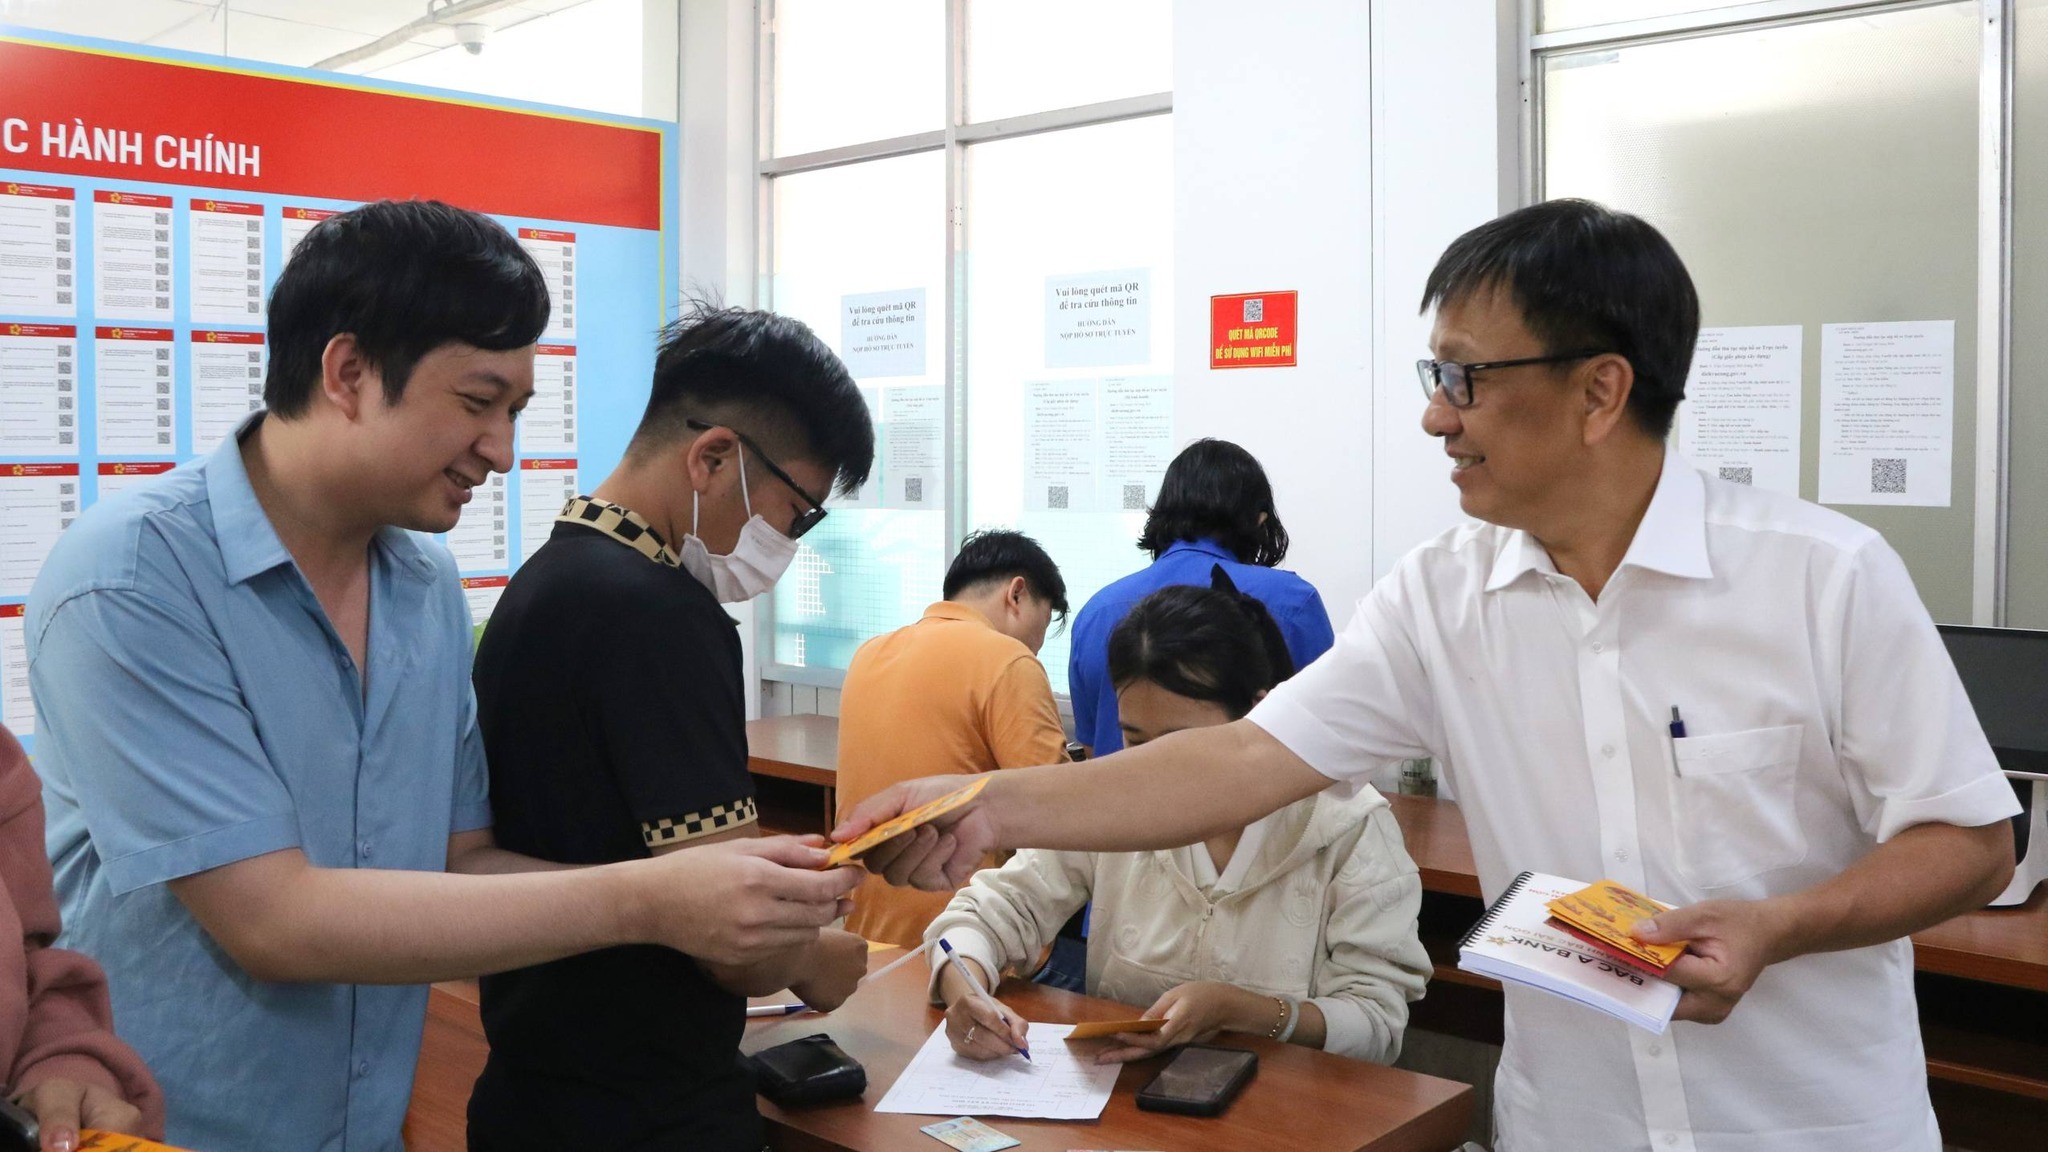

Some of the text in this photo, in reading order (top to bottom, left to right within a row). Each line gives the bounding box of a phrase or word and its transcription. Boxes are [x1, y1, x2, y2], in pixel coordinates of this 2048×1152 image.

[3, 118, 260, 177] C HÀNH CHÍNH
[1056, 282, 1139, 296] Vui lòng quét mã QR
[849, 301, 916, 314] Vui lòng quét mã QR
[1059, 296, 1138, 310] để tra cứu thông tin
[885, 315, 905, 324] thông
[905, 313, 915, 322] tin
[1228, 326, 1279, 341] QUÉT MÃ QRCODE
[1233, 347, 1249, 360] DỤNG
[1250, 346, 1264, 357] WIFI
[1264, 342, 1280, 357] MIỄN
[1281, 342, 1292, 357] PHÍ
[1511, 936, 1572, 959] BANK
[1578, 954, 1593, 964] A
